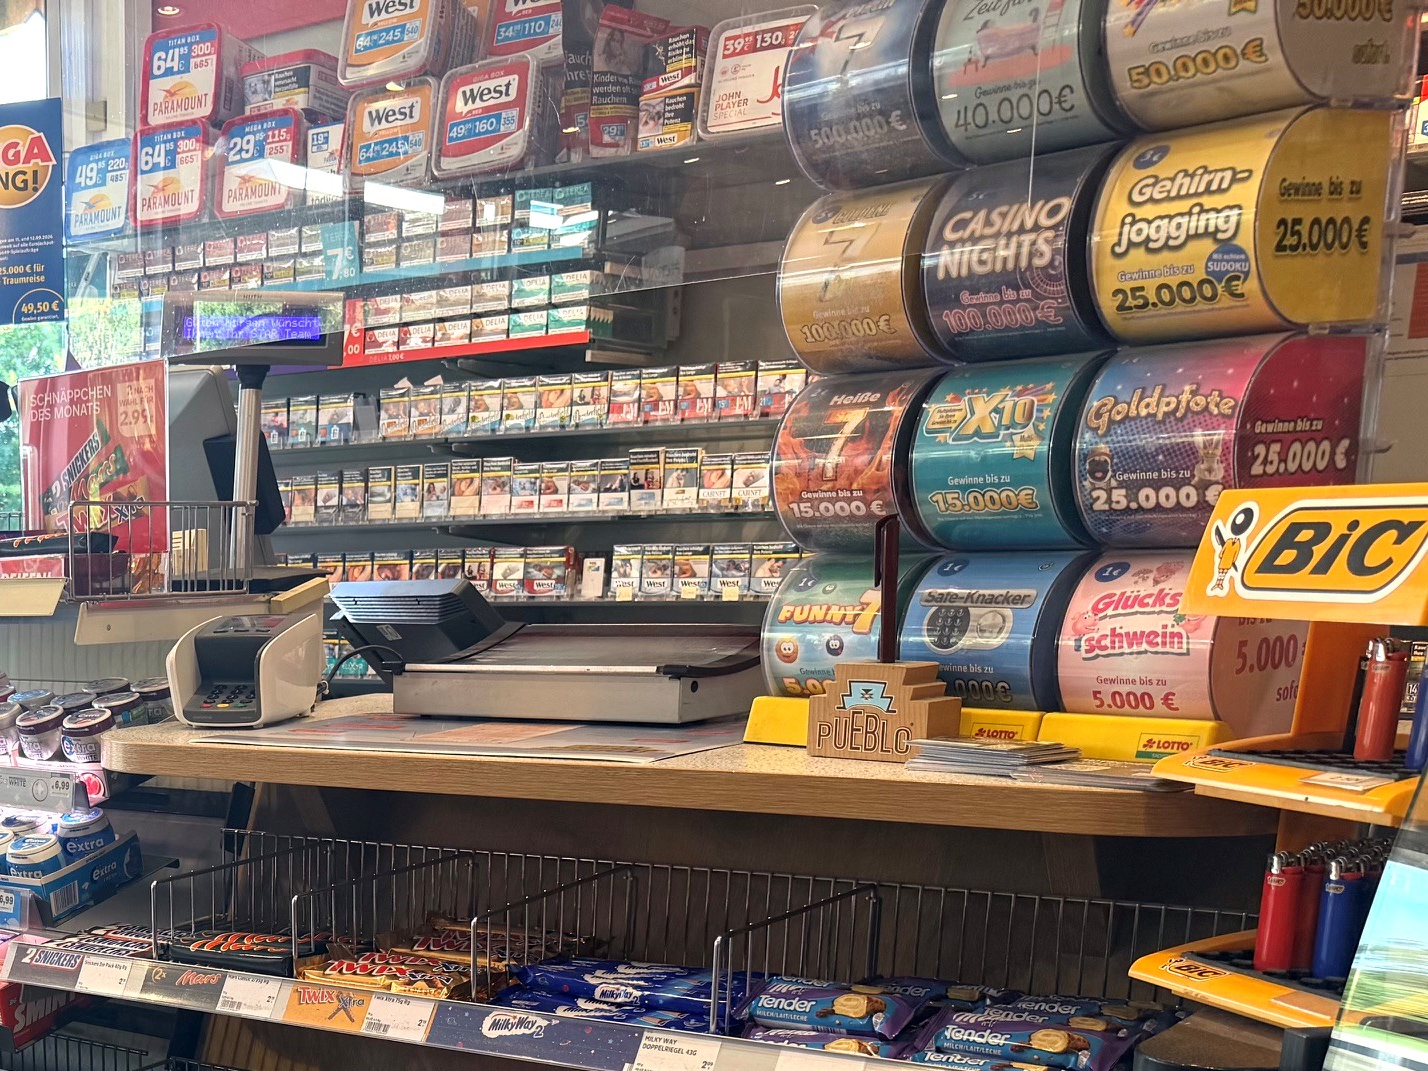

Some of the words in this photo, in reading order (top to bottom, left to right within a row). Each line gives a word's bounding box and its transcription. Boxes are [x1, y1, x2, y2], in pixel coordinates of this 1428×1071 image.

[169, 37, 186, 47] TITAN
[187, 35, 200, 44] BOX
[1128, 46, 1240, 90] 50.000
[1241, 37, 1269, 65] €
[660, 72, 681, 85] West
[461, 79, 512, 106] West
[716, 90, 742, 103] JOHN
[152, 93, 209, 117] PARAMOUNT
[367, 102, 415, 126] West
[714, 99, 749, 112] PLAYER
[713, 109, 748, 122] SPECIAL
[656, 135, 677, 146] West
[1128, 166, 1253, 207] Gehirn-
[141, 189, 195, 213] PARAMOUNT
[73, 206, 122, 228] PARAMOUNT
[942, 195, 1073, 242] CASINO
[1111, 203, 1242, 257] jogging
[936, 228, 1056, 280] NIGHTS
[25, 264, 32, 275] €
[33, 263, 45, 274] für
[1117, 266, 1161, 283] Gewinne
[1163, 264, 1179, 278] bis
[1180, 264, 1195, 276] zu
[1207, 260, 1250, 273] SUDOKU
[3, 274, 46, 286] Traumreise
[1111, 278, 1219, 313] 25.000
[1221, 273, 1246, 299] €
[21, 301, 50, 314] 49,50
[51, 300, 60, 312] €
[485, 317, 506, 329] DELIA
[942, 302, 1034, 334] 100.000
[30, 385, 112, 408] SCHNÄPPCHEN
[828, 391, 881, 407] Heiße
[31, 406, 53, 422] DES
[54, 402, 101, 420] MONATS
[1085, 382, 1237, 438] Goldpfote
[1090, 484, 1199, 512] 25.000
[923, 590, 1032, 607] Safe-Knacker
[1089, 587, 1184, 615] Glücks
[1084, 623, 1185, 655] schwein
[1096, 676, 1137, 687] Gewinne
[1138, 675, 1153, 687] bis
[1155, 678, 1167, 687] zu
[1091, 690, 1155, 712] 5.000
[1160, 691, 1180, 712] €
[984, 728, 1019, 741] LOTTO
[1155, 740, 1194, 751] LOTTO
[65, 836, 105, 853] extra
[33, 950, 83, 969] SNICKERS
[175, 969, 222, 986] Mars
[756, 994, 816, 1014] Tender
[756, 1009, 809, 1022] MILCH/LAIT/LECHE
[642, 1043, 685, 1055] DOPPELRIEGEL
[645, 1036, 663, 1045] MILKY
[663, 1038, 678, 1046] WAY
